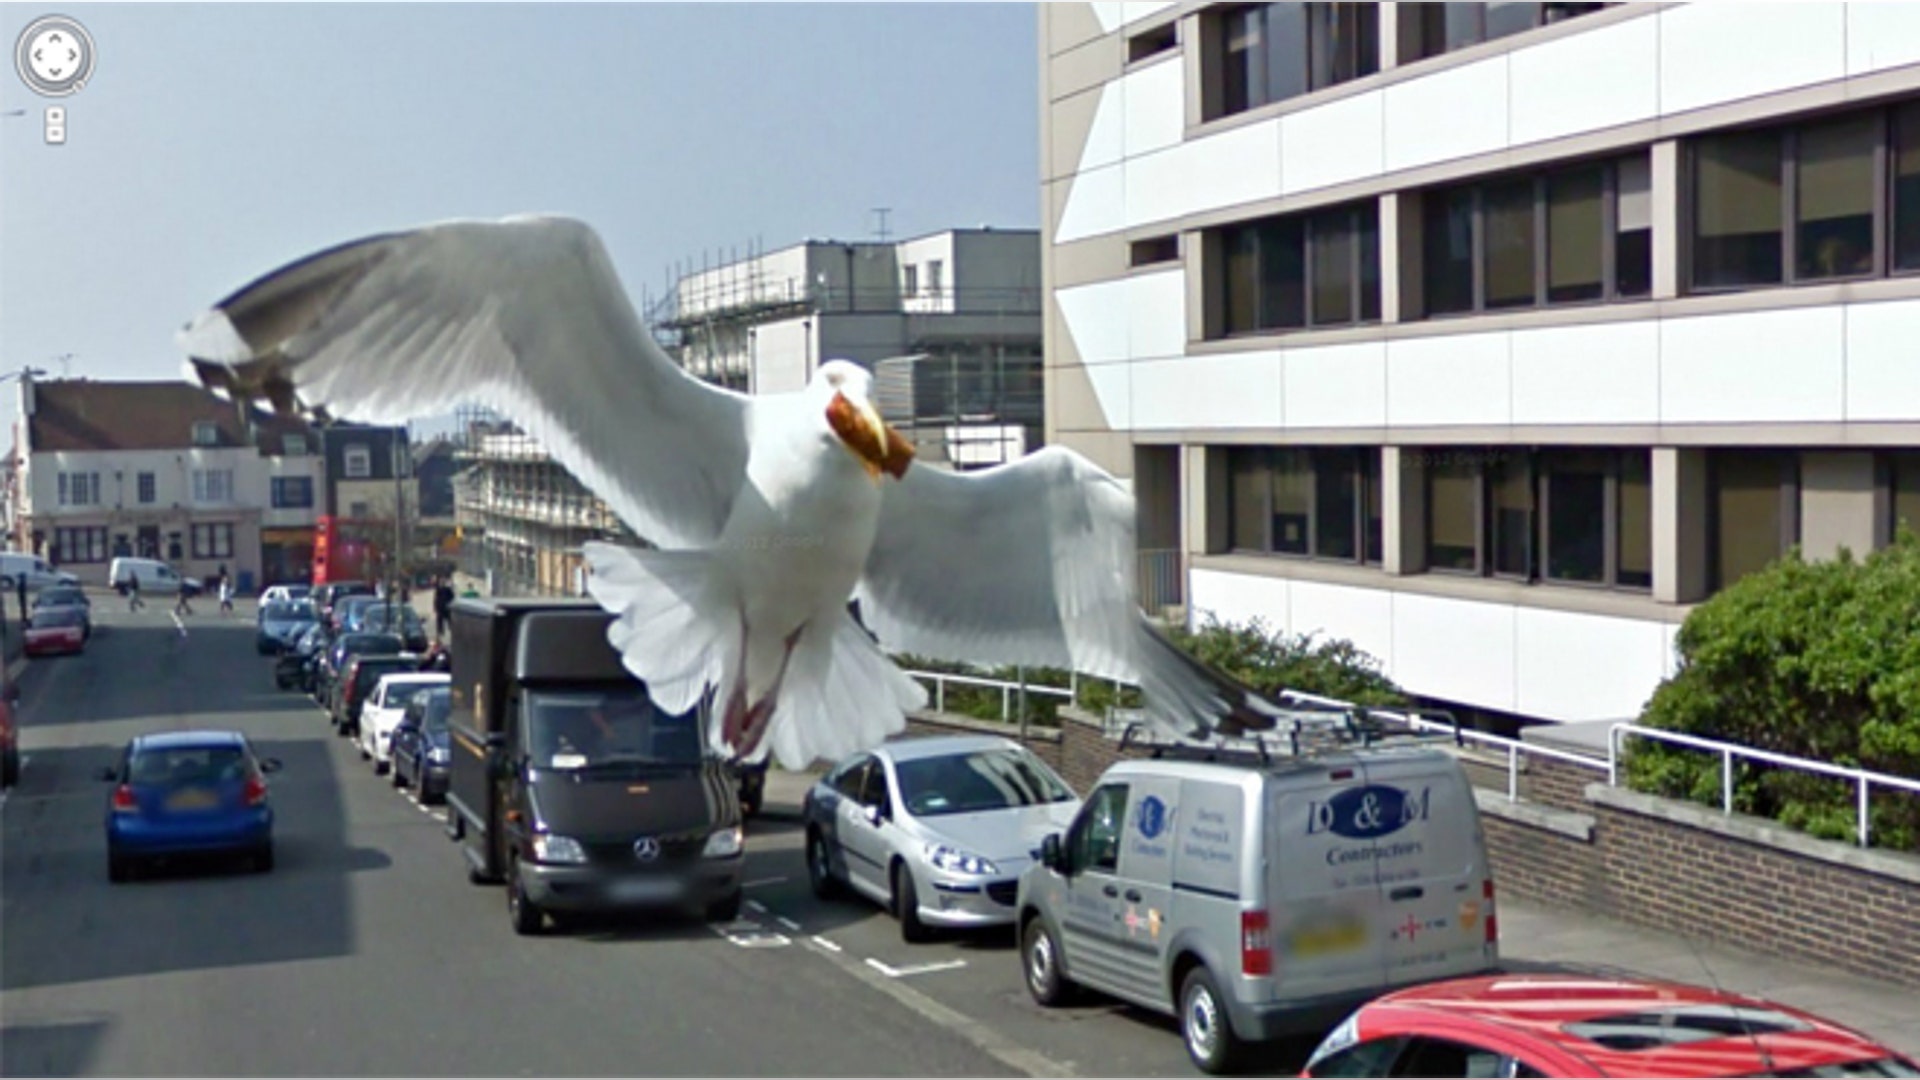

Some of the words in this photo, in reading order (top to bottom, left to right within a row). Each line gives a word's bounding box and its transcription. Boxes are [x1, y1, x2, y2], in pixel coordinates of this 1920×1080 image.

[1305, 800, 1334, 835] D
[1353, 791, 1385, 830] &
[1399, 786, 1430, 823] M
[1325, 841, 1423, 867] Contractors
